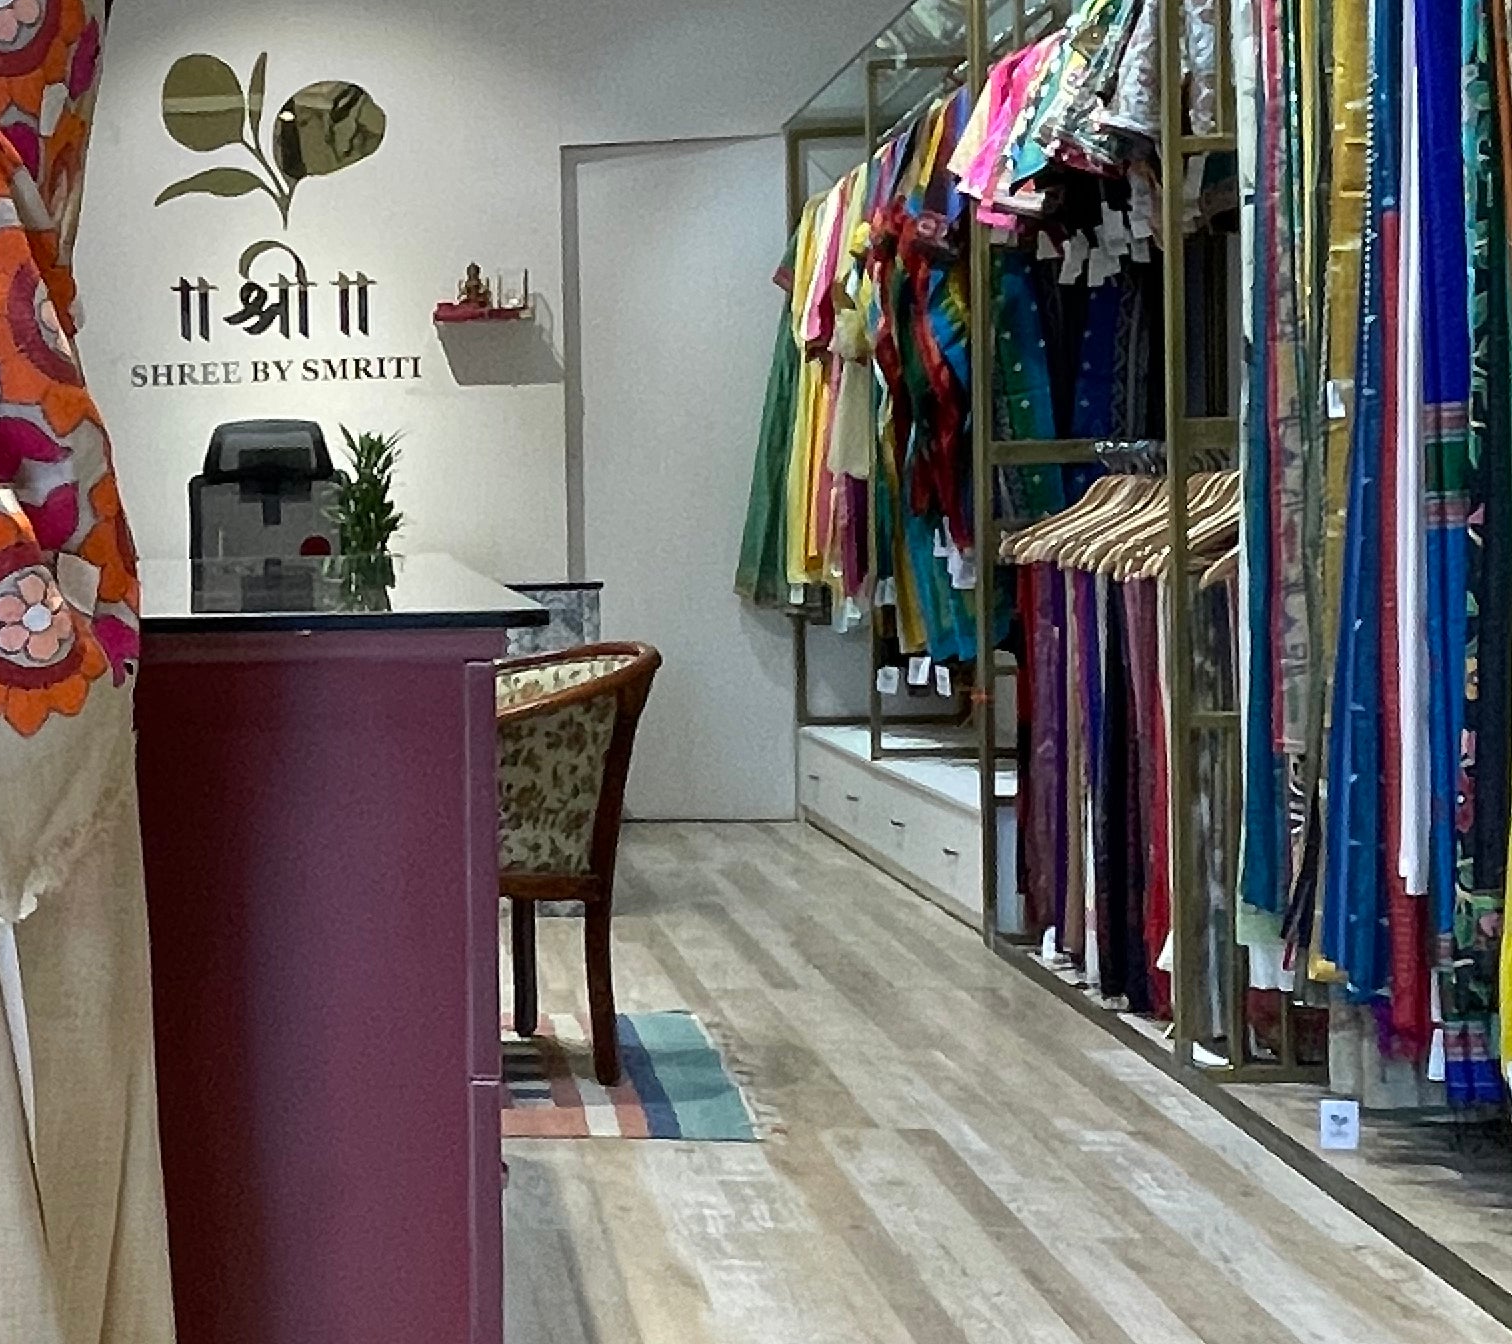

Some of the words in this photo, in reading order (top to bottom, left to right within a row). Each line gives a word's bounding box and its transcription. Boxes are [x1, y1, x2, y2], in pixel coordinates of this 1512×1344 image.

[222, 240, 318, 340] श्री
[130, 361, 242, 387] SHREE
[251, 359, 294, 383] BY
[301, 356, 422, 382] SMRITI
